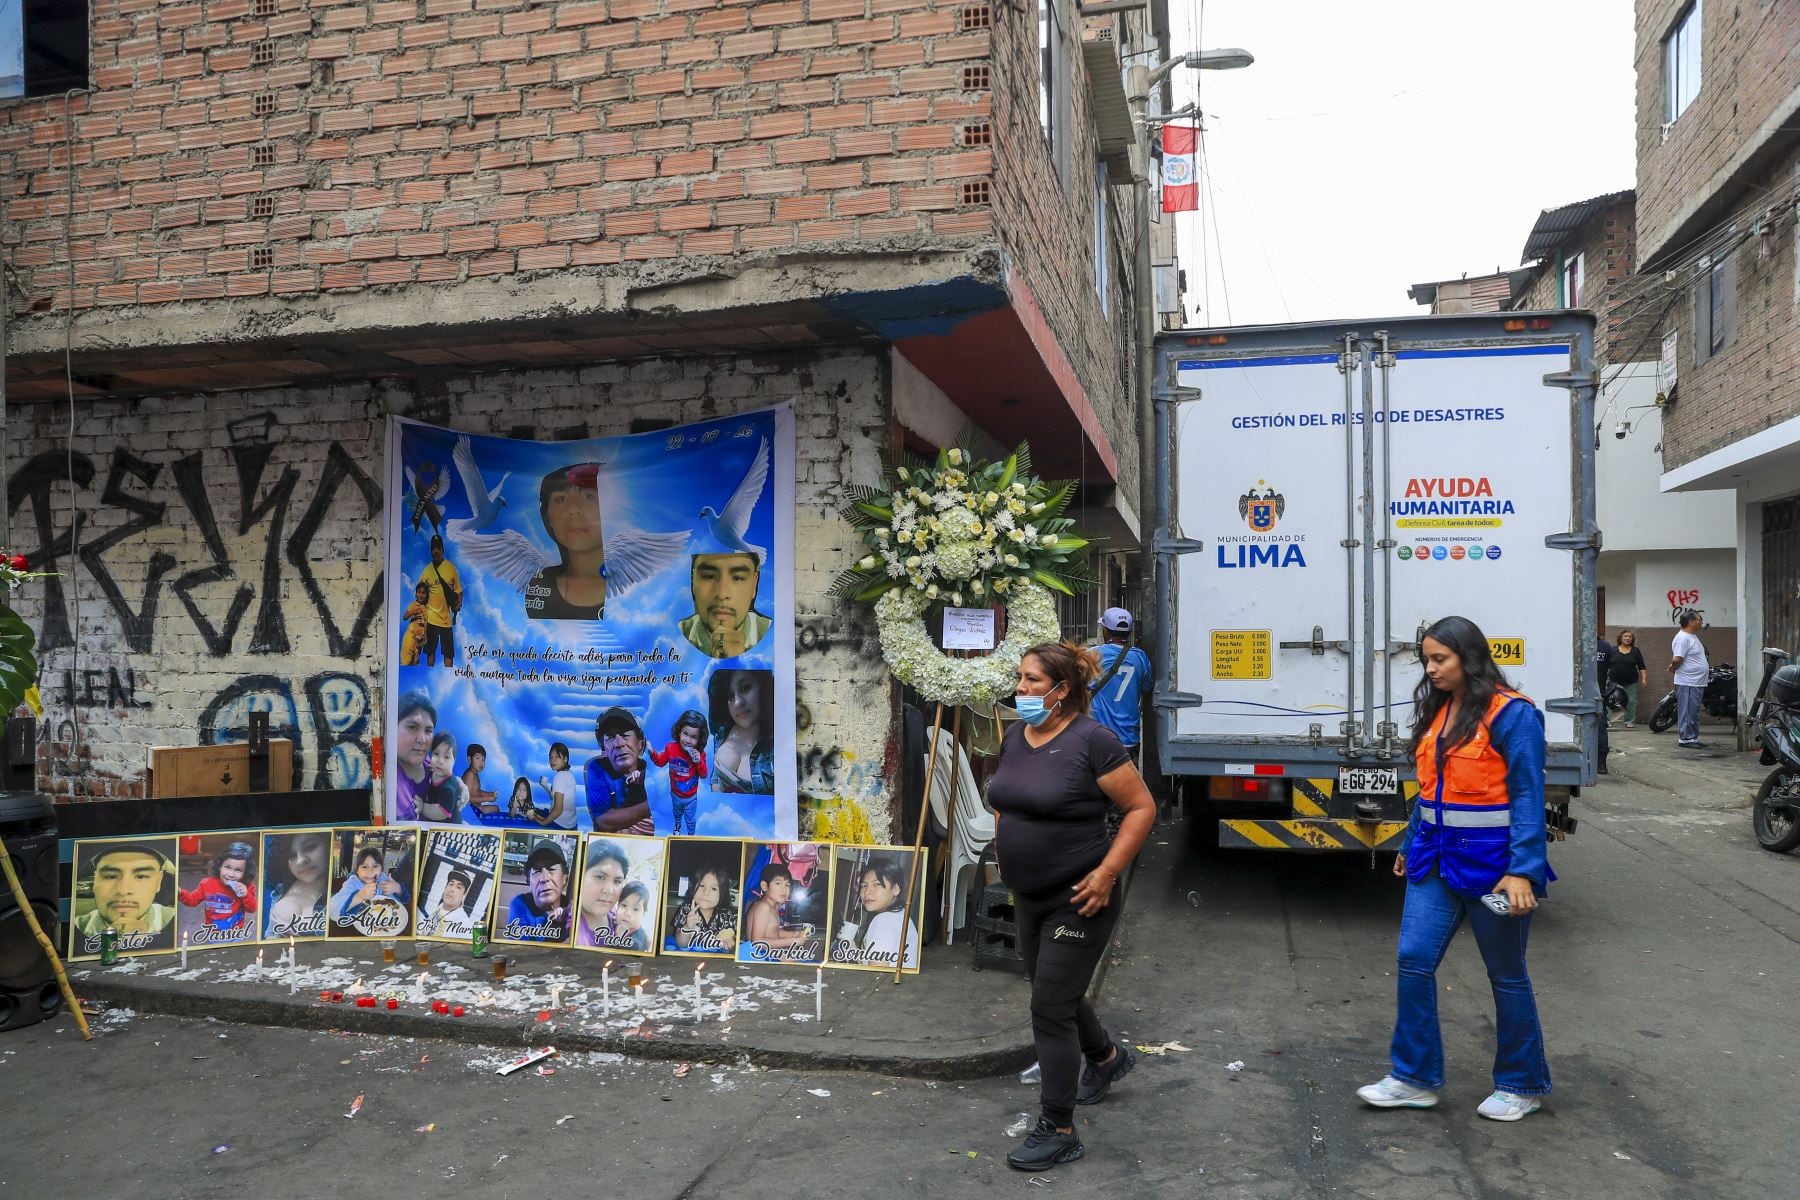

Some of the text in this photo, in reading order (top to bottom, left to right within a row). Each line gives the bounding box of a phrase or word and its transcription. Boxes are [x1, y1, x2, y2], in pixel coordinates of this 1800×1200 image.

[1231, 407, 1505, 428] GESTIÓN DEL RISO DE DESASTRES
[1404, 477, 1493, 498] AYUDA
[1384, 500, 1516, 515] HUMANITARIA
[1447, 519, 1465, 527] tarea
[1217, 534, 1307, 543] MUNICIPALIDAD DE
[1217, 544, 1307, 568] LIMA
[491, 648, 506, 659] me
[509, 646, 539, 668] queda
[542, 646, 575, 662] decirte
[578, 647, 604, 664] adiós
[608, 653, 635, 670] para
[636, 647, 664, 663] toda
[668, 647, 682, 662] la
[480, 669, 515, 688] aunque
[517, 667, 540, 682] toda
[543, 668, 555, 682] la
[581, 672, 602, 691] siga
[606, 669, 658, 691] pensando
[663, 675, 677, 684] en
[1117, 665, 1135, 702] 7
[337, 905, 401, 934] Aylen
[503, 917, 562, 939] Leonidas
[593, 926, 634, 948] Paola
[681, 927, 723, 949] Mia
[750, 940, 819, 961] Darkiel
